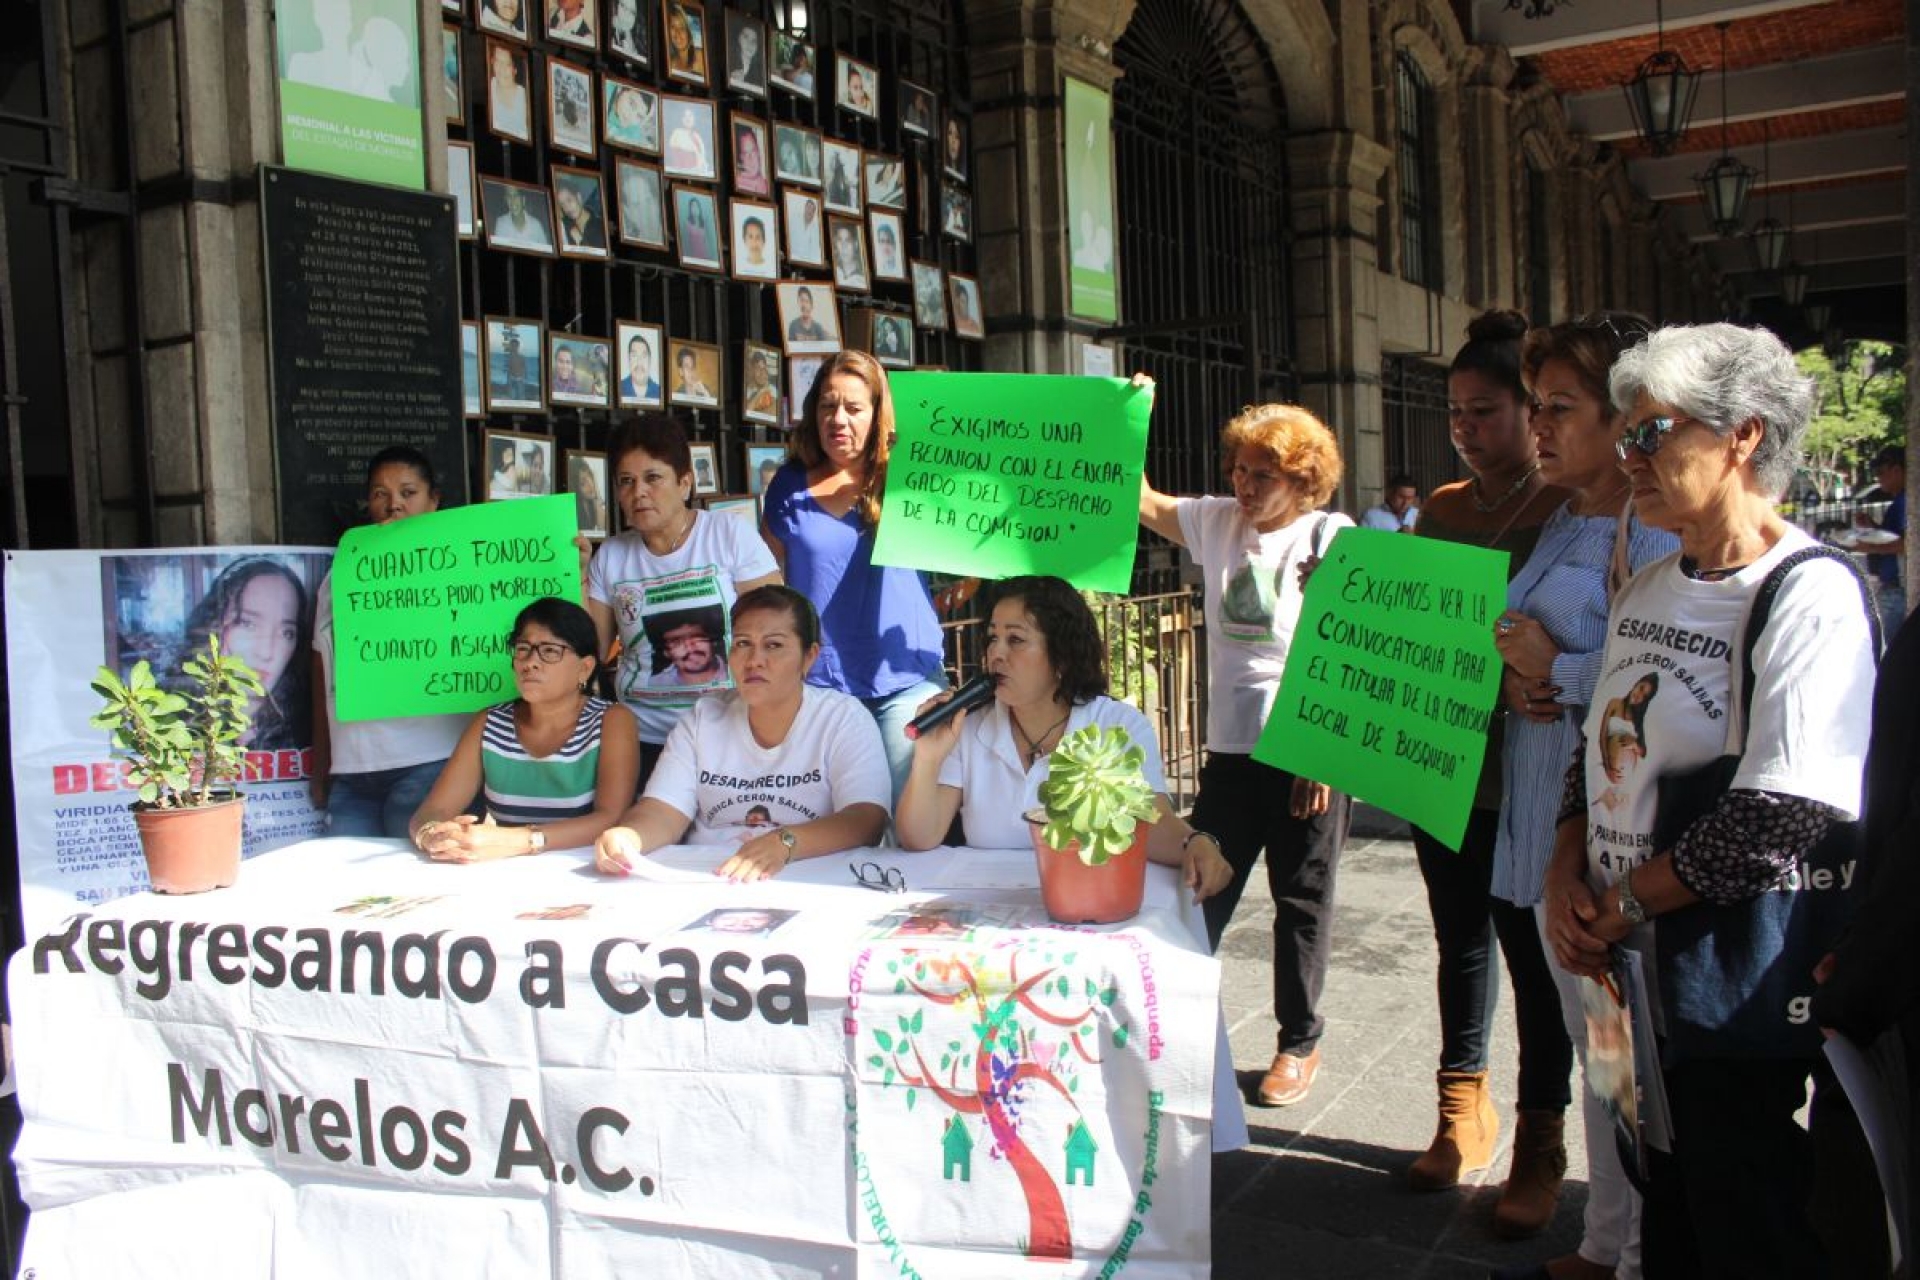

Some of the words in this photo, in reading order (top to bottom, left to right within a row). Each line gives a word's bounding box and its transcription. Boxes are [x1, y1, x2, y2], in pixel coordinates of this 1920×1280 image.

[1041, 422, 1083, 443] UNA
[909, 441, 991, 473] REUNION
[1000, 455, 1036, 477] CON
[1043, 459, 1064, 480] EL
[905, 471, 956, 497] GADO
[967, 481, 1000, 503] DEL
[1017, 484, 1113, 517] DESPACHO
[902, 500, 923, 521] DE
[935, 506, 956, 527] LA
[471, 536, 556, 568] FONDOS
[347, 586, 441, 612] FEDERALES
[447, 584, 485, 607] PIDIO
[1439, 586, 1464, 619] VER
[1472, 595, 1487, 628] LA
[1317, 611, 1447, 677] CONVOCATORIA
[1453, 647, 1487, 684] PARA
[1617, 618, 1734, 664] ESAPARECID
[424, 671, 502, 696] ESTADO
[1306, 655, 1329, 684] EL
[1340, 663, 1396, 706] TITULAR
[1402, 682, 1420, 713] DE
[1423, 689, 1440, 722] LA
[1297, 694, 1350, 739] LOCAL
[1361, 720, 1385, 754] DE
[247, 789, 305, 803] RALES
[700, 769, 821, 791] DESAPARECIDOS
[736, 792, 775, 804] CERON
[89, 823, 135, 836] BLANC
[32, 912, 496, 1006] Regresando
[519, 937, 567, 1010] a
[589, 936, 810, 1027] Casa
[166, 1062, 471, 1177] Morelos
[495, 1098, 657, 1197] A.C.
[1135, 1190, 1152, 1215] de
